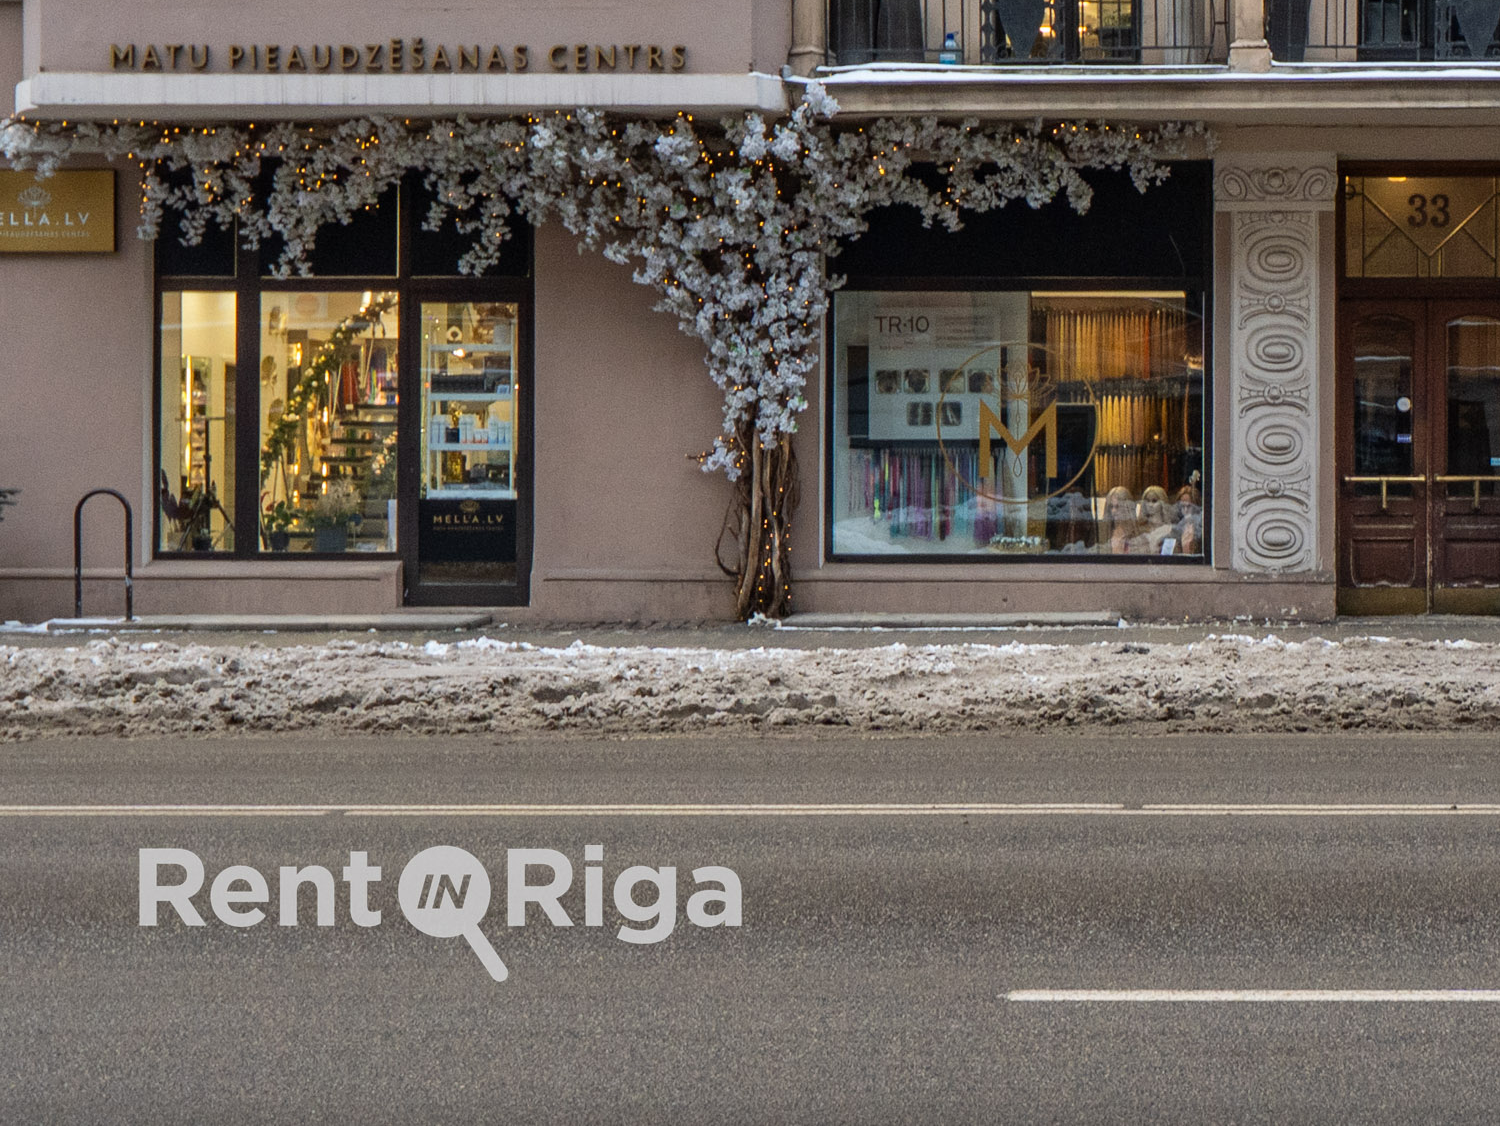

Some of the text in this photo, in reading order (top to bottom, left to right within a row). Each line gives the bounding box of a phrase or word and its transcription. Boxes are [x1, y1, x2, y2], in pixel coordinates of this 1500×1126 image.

[109, 37, 687, 70] MATU PIEAUDZĒŠANAS CENTRS
[1407, 193, 1450, 228] 33
[433, 515, 503, 524] MELLA.LV
